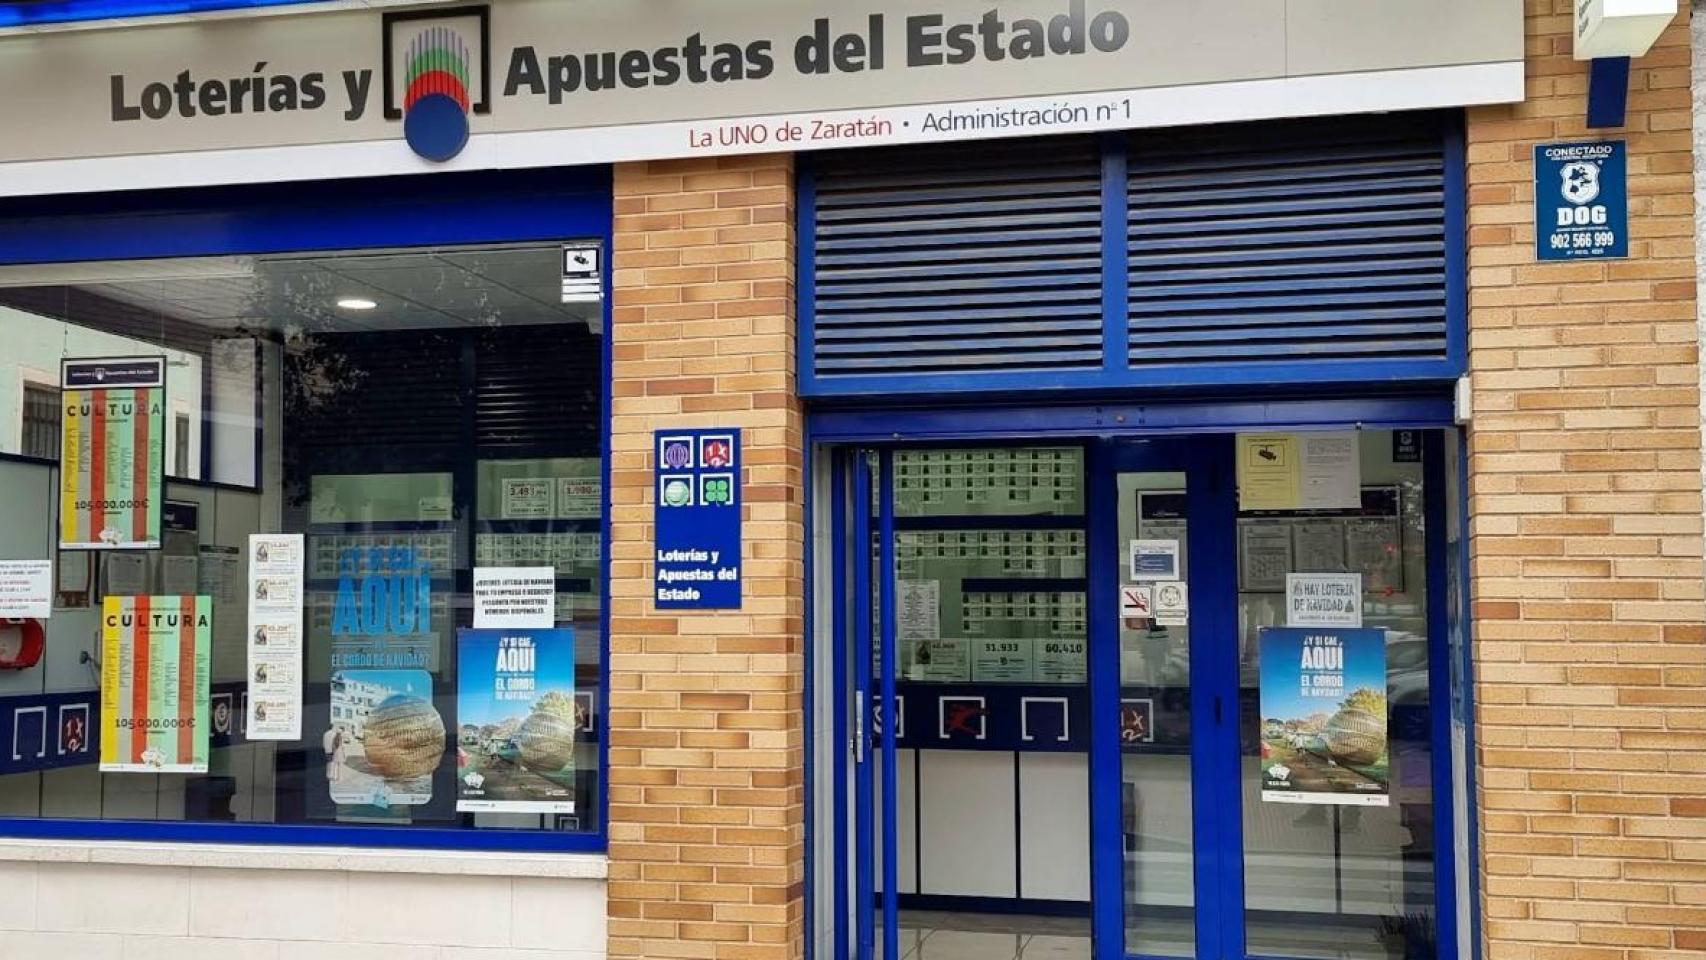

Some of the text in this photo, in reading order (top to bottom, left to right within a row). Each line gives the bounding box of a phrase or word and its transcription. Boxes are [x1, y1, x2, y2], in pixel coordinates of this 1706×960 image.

[110, 0, 1130, 121] Loterías y Apuestas del Estado
[689, 128, 713, 148] La
[719, 124, 767, 146] UNO
[775, 121, 802, 143] de
[810, 114, 892, 140] Zaratán
[922, 101, 1088, 133] Administración
[1123, 100, 1131, 119] 1
[1545, 146, 1612, 157] CONECTADO
[1557, 205, 1607, 226] DOG
[1550, 231, 1614, 249] 902 566 999
[67, 403, 161, 416] CULTURA
[658, 549, 719, 564] Loterías y
[658, 567, 737, 584] Apuestas del
[658, 588, 700, 601] Estado
[1304, 583, 1320, 595] HAY
[1294, 599, 1343, 611] DE NAVIDAD
[106, 614, 208, 627] CULTURA
[496, 643, 535, 671] AQUÍ
[1301, 642, 1343, 669] AQUÍ
[496, 678, 505, 690] EL
[1301, 675, 1312, 687] EL
